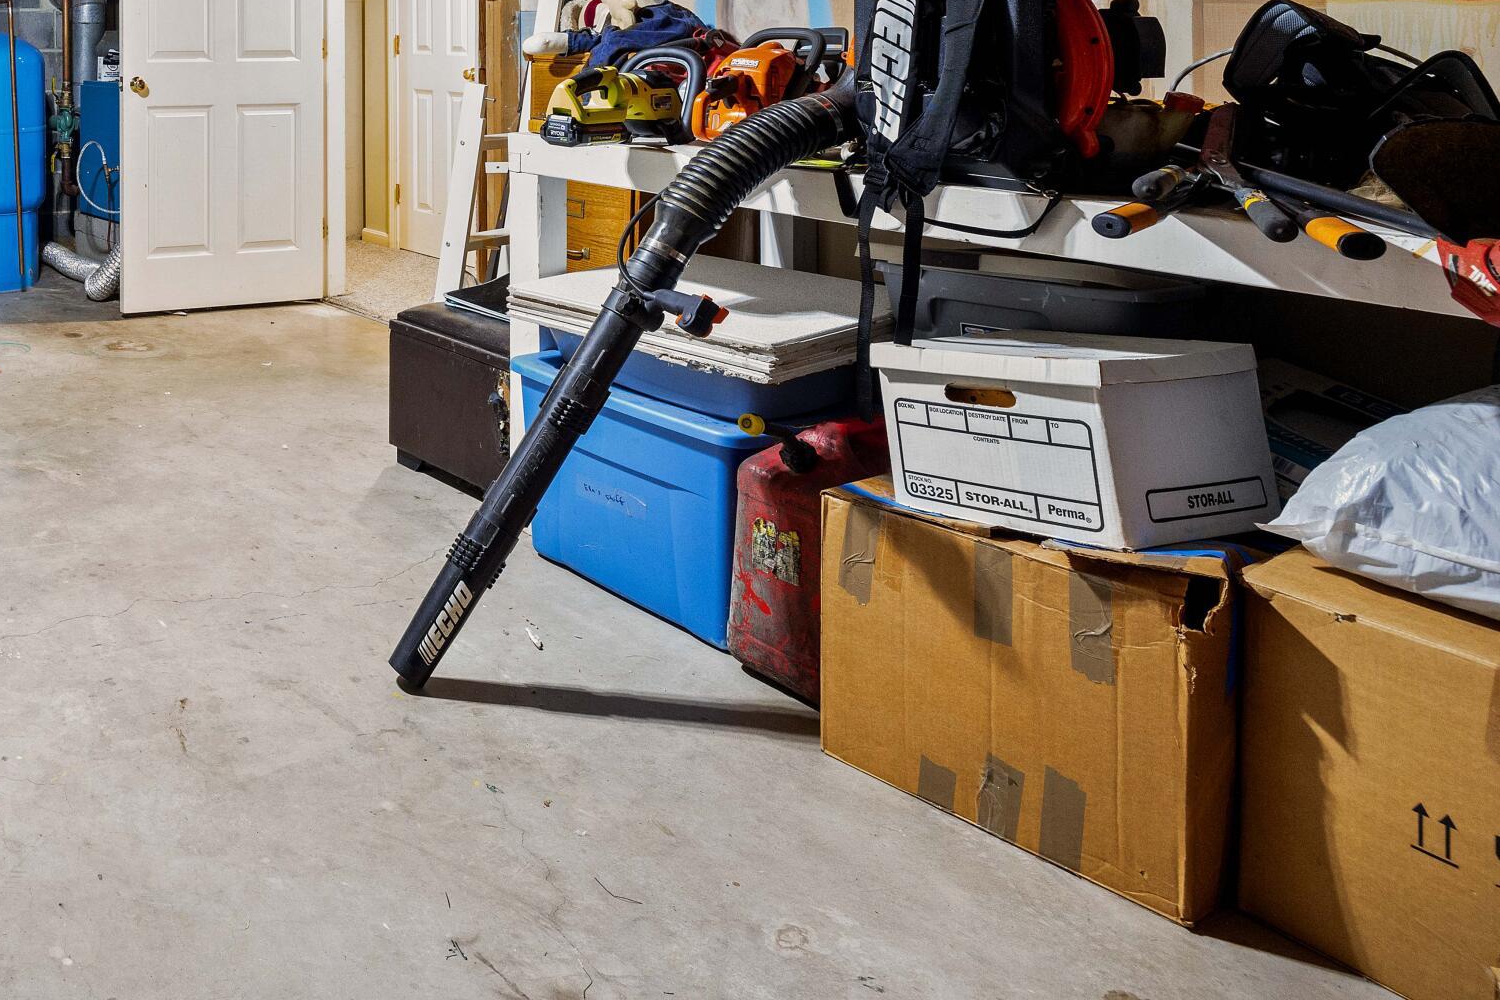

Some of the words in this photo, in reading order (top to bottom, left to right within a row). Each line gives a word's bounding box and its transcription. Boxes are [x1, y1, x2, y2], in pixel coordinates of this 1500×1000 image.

[871, 9, 915, 143] ECHO
[939, 407, 964, 417] LOCATION
[968, 412, 992, 421] DESTROY
[992, 415, 1006, 423] DATE
[1011, 417, 1029, 425] FROM
[972, 435, 1000, 445] CONTENTS
[908, 474, 923, 482] STOCK
[910, 481, 954, 501] 03325
[1187, 490, 1235, 509] STOR-ALL
[426, 580, 473, 656] ECHO
